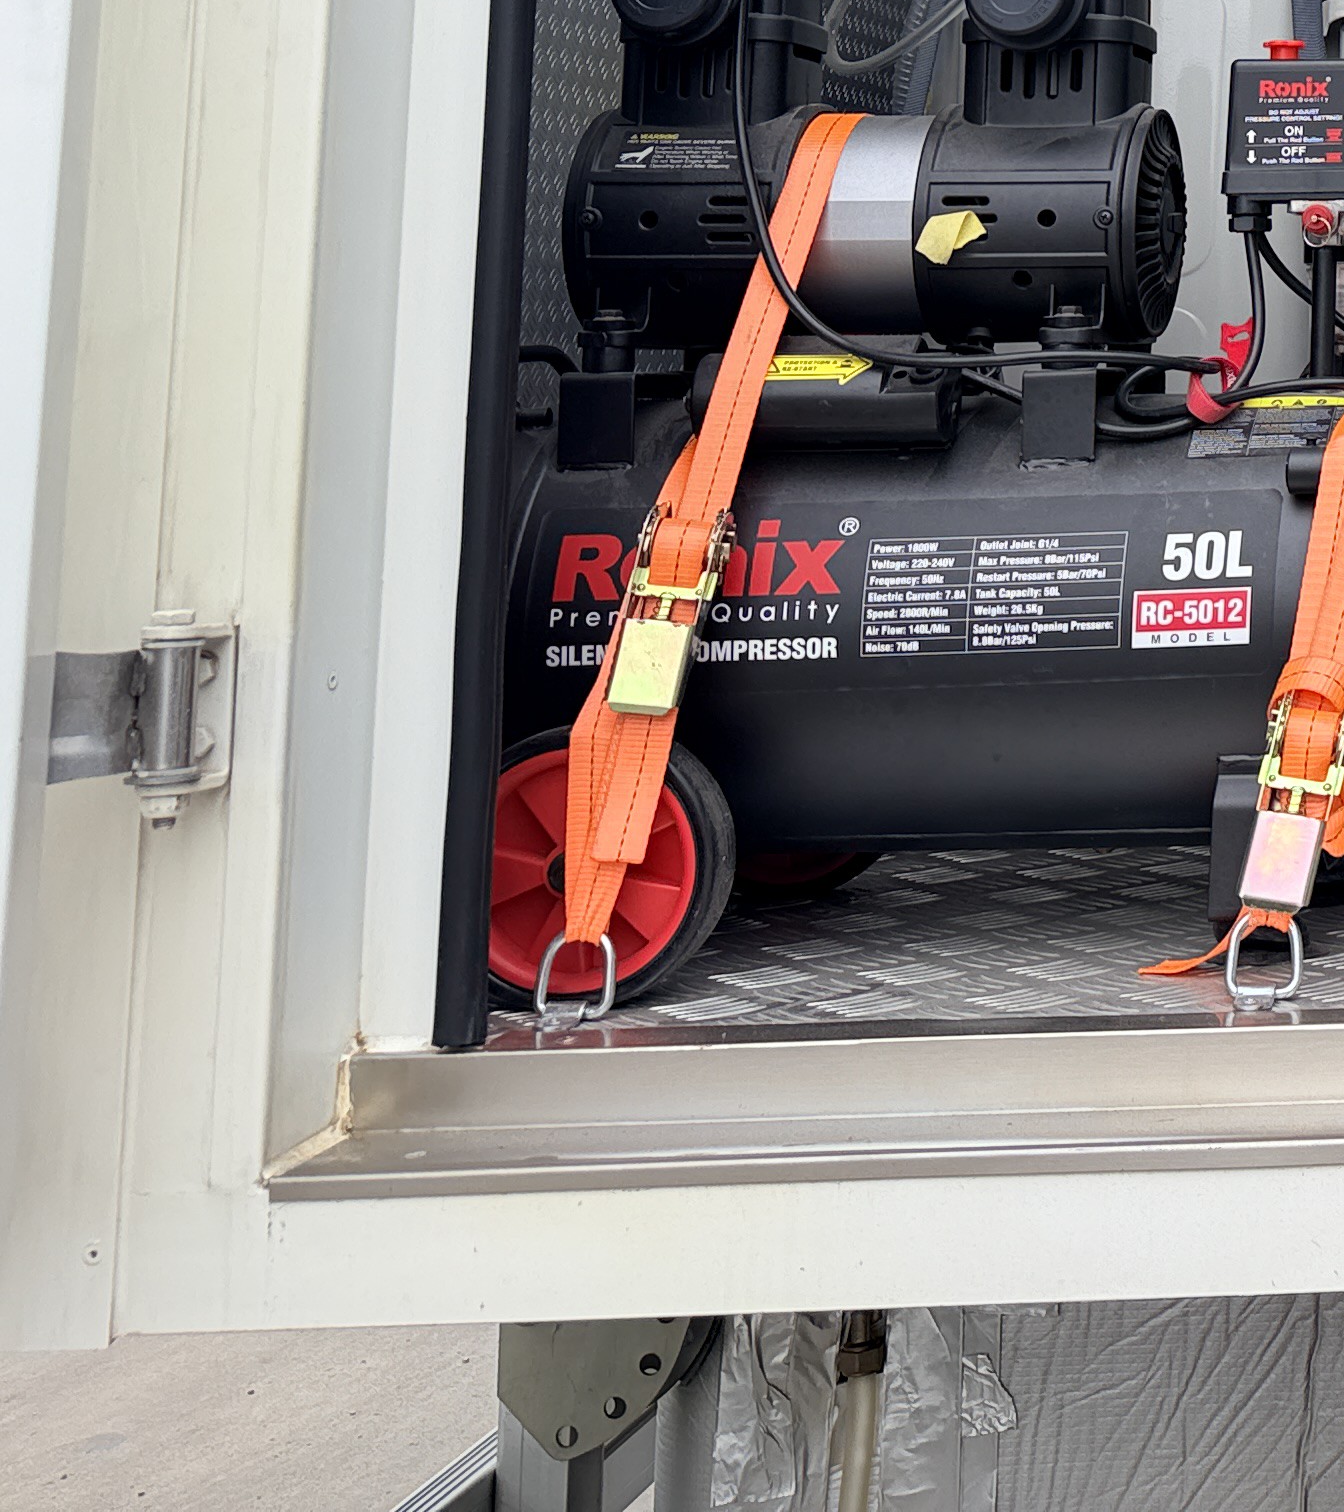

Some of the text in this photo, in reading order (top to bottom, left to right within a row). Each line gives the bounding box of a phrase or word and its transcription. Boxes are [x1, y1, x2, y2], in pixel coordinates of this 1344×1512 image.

[1259, 76, 1329, 97] Ronix
[1297, 96, 1329, 104] Quality
[1284, 125, 1304, 136] ON
[1281, 145, 1307, 157] OFF
[874, 542, 939, 554] Power: 1800W
[980, 540, 1008, 550] Outlet
[1010, 539, 1036, 549] Joint:
[552, 519, 846, 602] Rix
[978, 556, 998, 566] Max
[1000, 555, 1043, 565] Pressure:
[1162, 530, 1253, 581] 50L
[871, 557, 955, 571] Voltage: 220-240V
[869, 574, 945, 587] Frequency: 50Hz
[976, 572, 1010, 583] Restart
[1012, 571, 1056, 581] Pressure:
[867, 591, 904, 603] Electric
[905, 591, 943, 602] Current:
[975, 585, 1061, 600] Tank Capacity: 50L
[711, 600, 840, 624] Quality
[866, 608, 899, 621] Speed:
[974, 605, 1009, 617] Weight:
[1140, 597, 1244, 626] RC-5012
[865, 626, 879, 636] Air
[881, 625, 906, 636] Flow:
[972, 620, 1114, 635] Safety Valve Opening Pressure:
[1151, 632, 1232, 644] MODEL
[546, 637, 838, 668] SILEN OMPRESSOR
[865, 641, 920, 653] Noise: 70dB
